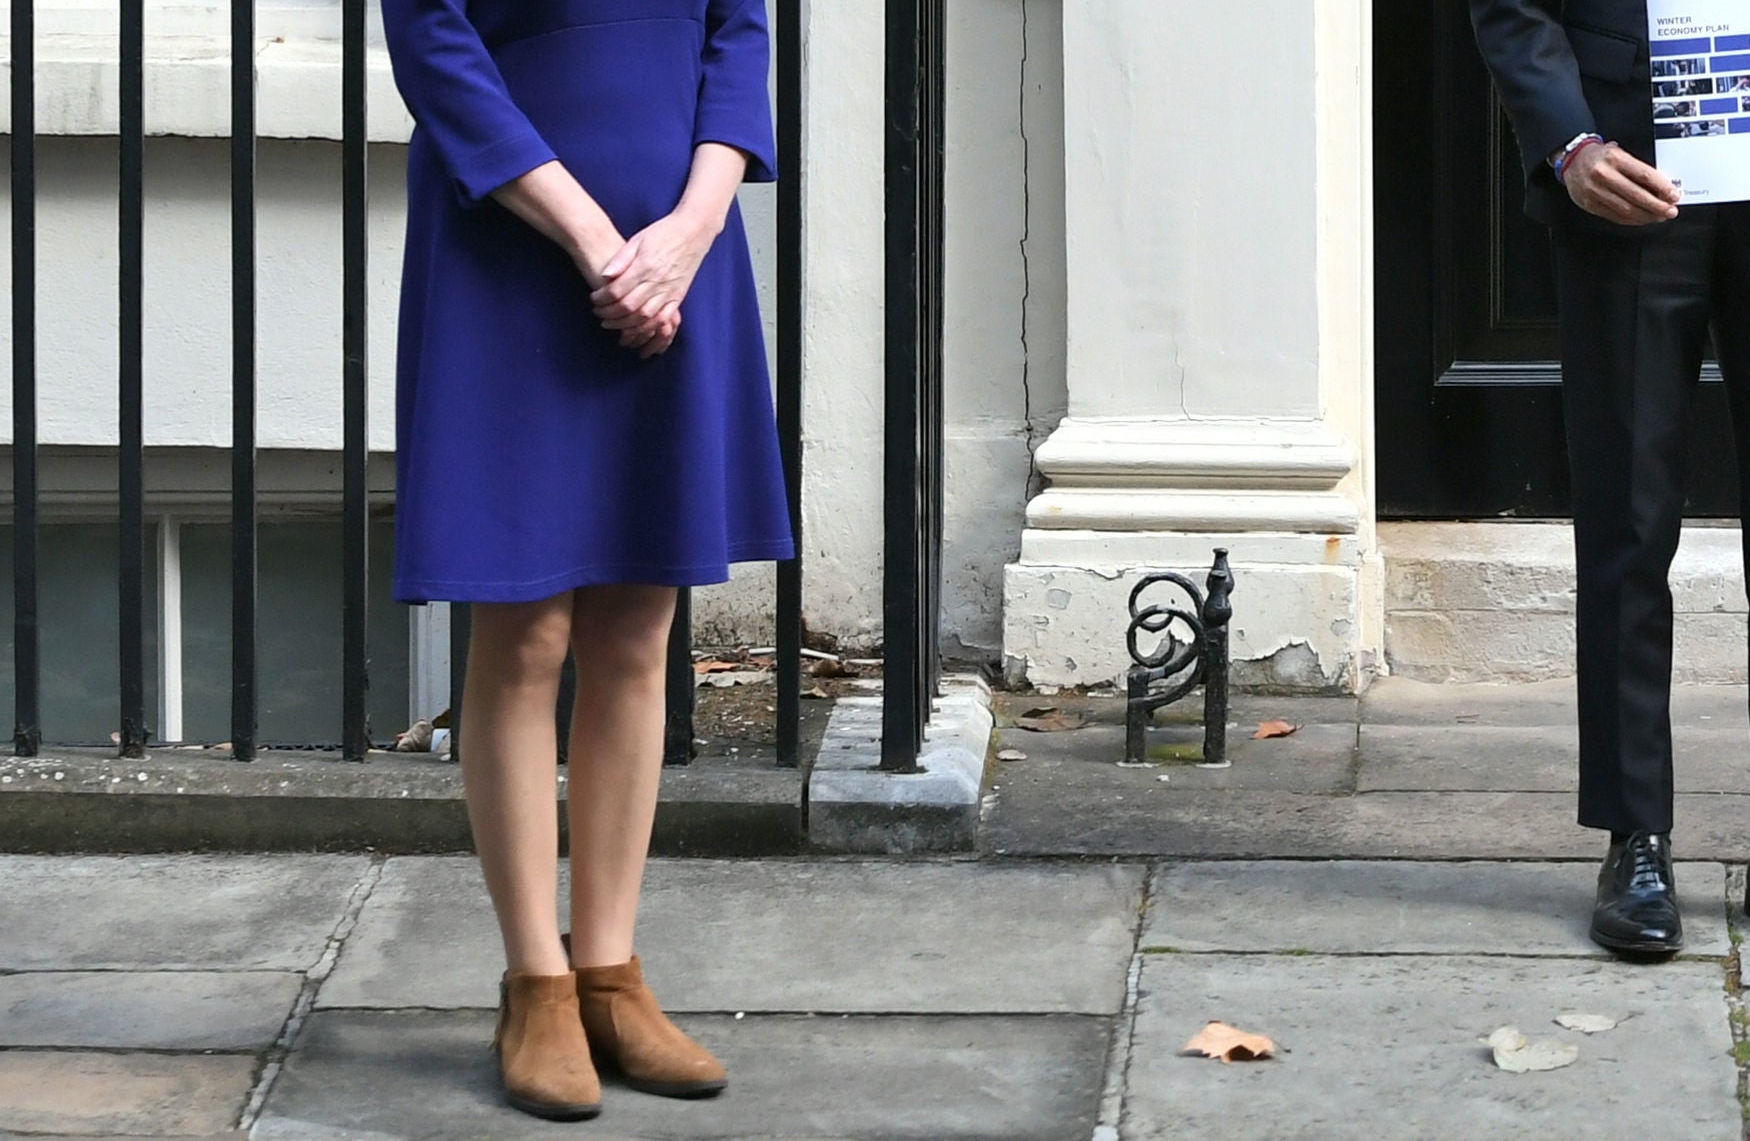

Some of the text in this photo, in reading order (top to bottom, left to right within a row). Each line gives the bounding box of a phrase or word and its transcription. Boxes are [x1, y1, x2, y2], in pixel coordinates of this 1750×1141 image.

[1657, 15, 1692, 26] WINTER
[1657, 24, 1729, 36] ECONOMY PLAN
